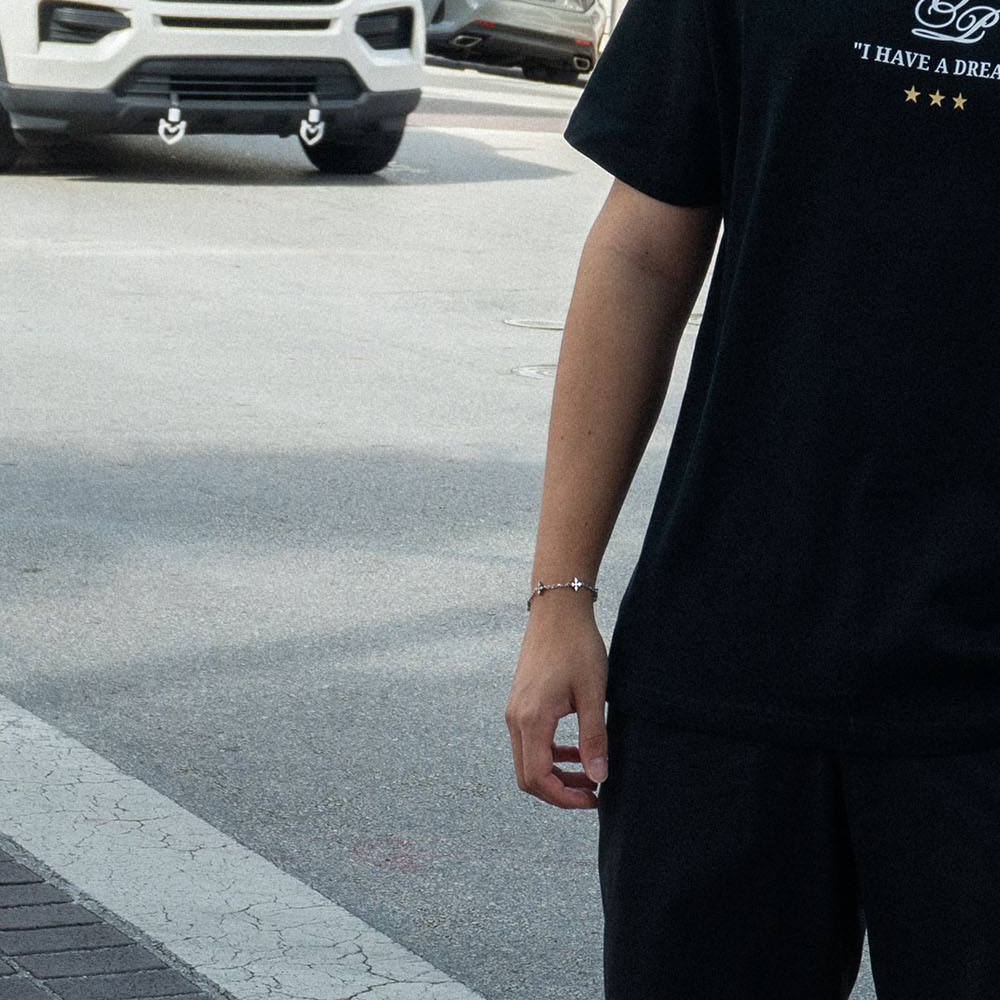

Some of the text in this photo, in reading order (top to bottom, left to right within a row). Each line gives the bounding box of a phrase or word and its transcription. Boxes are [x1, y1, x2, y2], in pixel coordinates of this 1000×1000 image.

[853, 41, 872, 60] "I
[873, 45, 931, 71] HAVE
[934, 57, 949, 74] A
